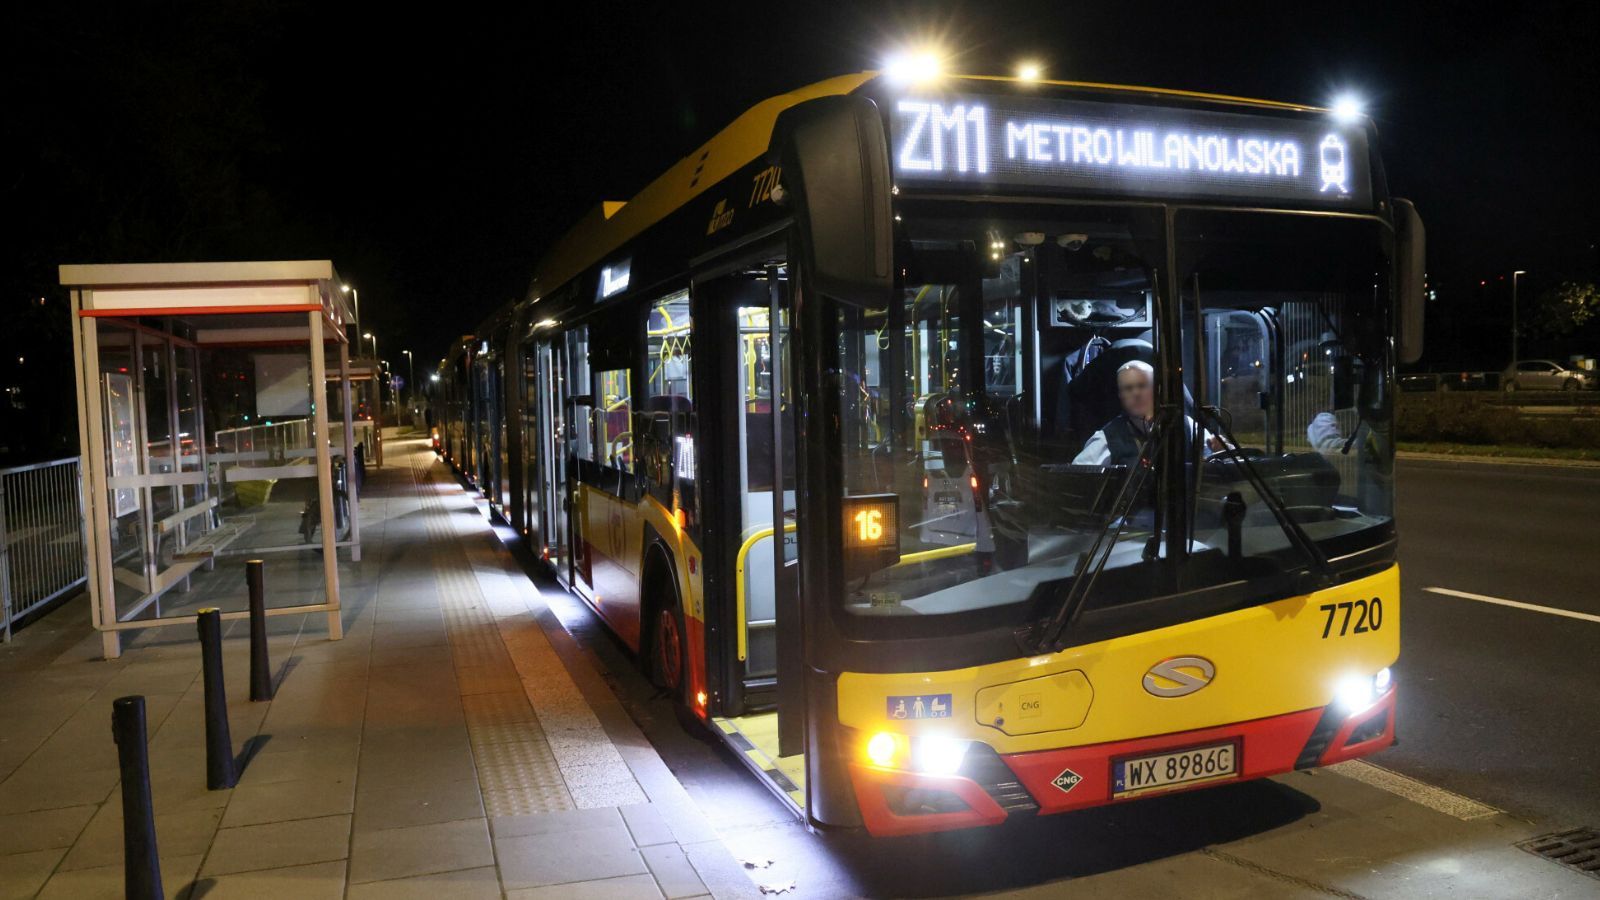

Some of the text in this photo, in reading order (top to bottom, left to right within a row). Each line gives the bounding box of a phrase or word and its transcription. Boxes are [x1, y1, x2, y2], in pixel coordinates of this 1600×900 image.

[897, 100, 1301, 177] ZM1 METRO WILANOWSKA
[855, 510, 882, 541] 16
[1320, 597, 1383, 640] 7720
[1021, 701, 1040, 711] CNG
[1056, 775, 1078, 786] CNG
[1129, 748, 1229, 787] WX 8986C
